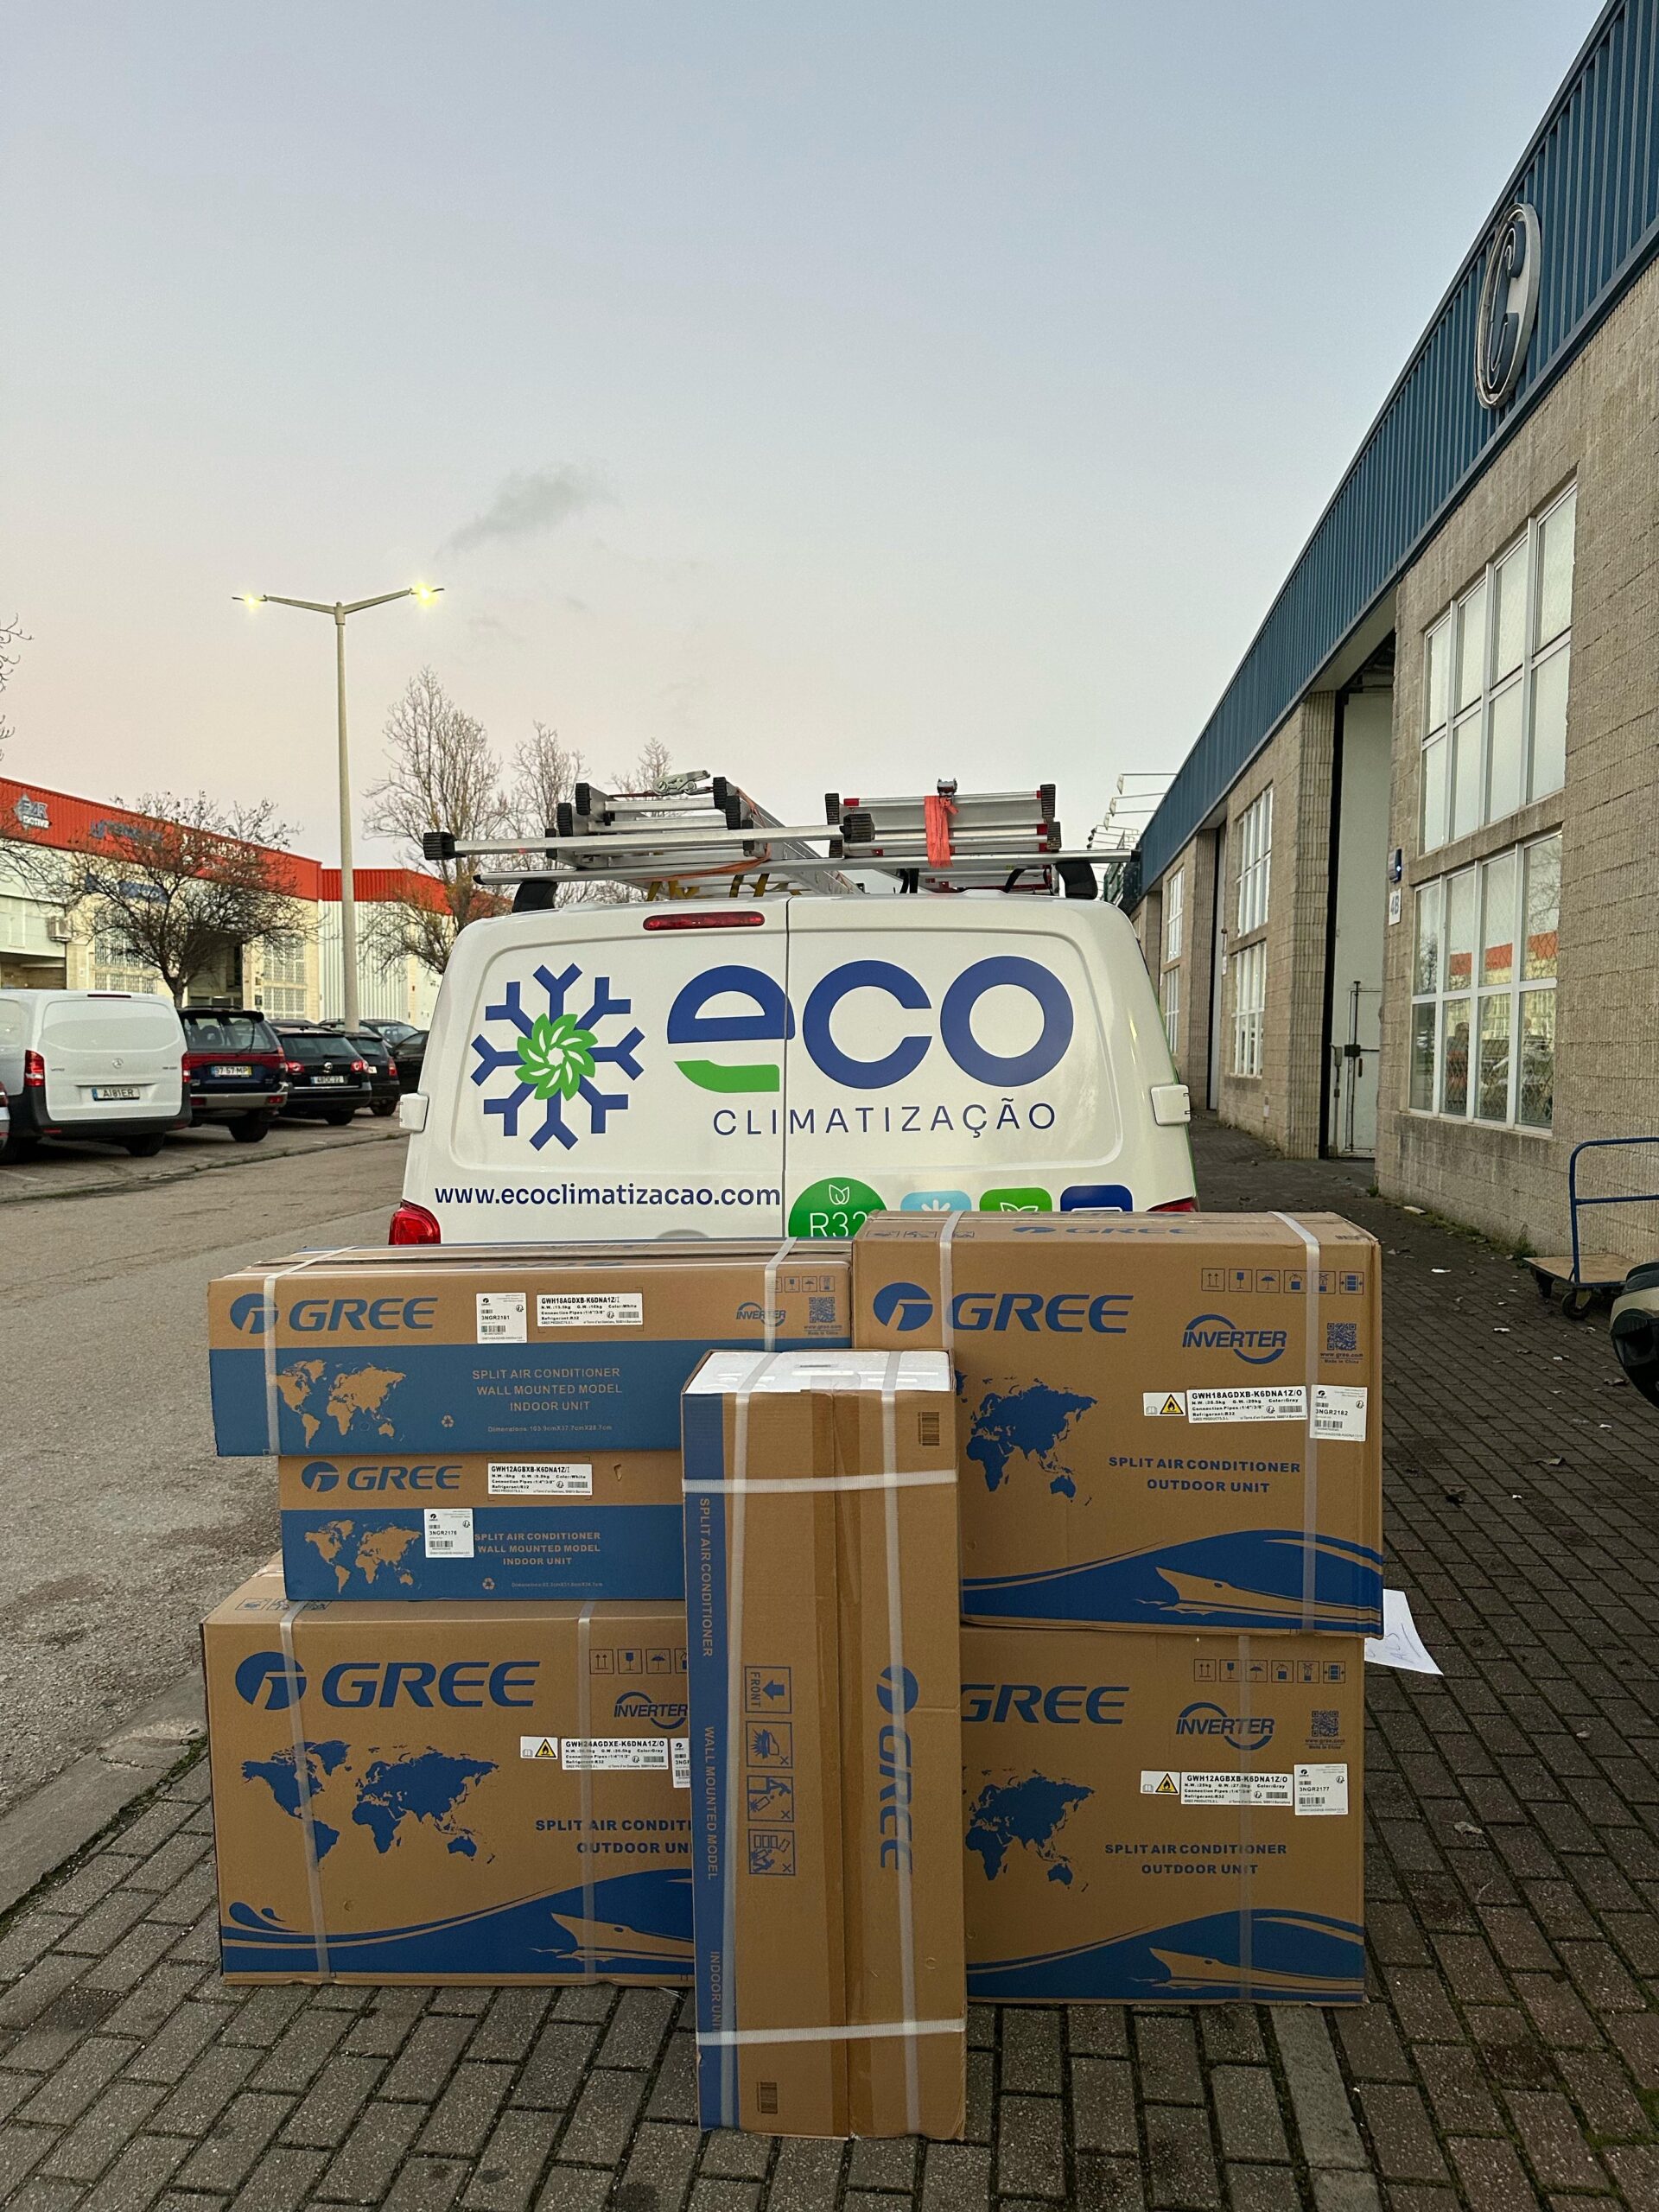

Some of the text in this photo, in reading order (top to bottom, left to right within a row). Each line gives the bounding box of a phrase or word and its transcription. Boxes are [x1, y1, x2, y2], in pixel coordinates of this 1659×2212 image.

[1389, 894, 1400, 916] 4B
[668, 956, 1074, 1093] eco
[713, 1097, 1056, 1138] CLIMATIZAÇÃO
[434, 1182, 779, 1205] www.ecoclimatizacao.com
[289, 1297, 438, 1332] GREE
[736, 1310, 786, 1319] INVERER
[946, 1293, 1134, 1334] GREE
[1182, 1330, 1287, 1348] INVERTER
[472, 1368, 620, 1380] SPLIT AIR CONDITIONER
[477, 1383, 623, 1395] WALL MOUNTED MODEL
[510, 1401, 590, 1411] INDOOR UNIT
[1109, 1457, 1300, 1472] SPLIT AIR CONDITIONER
[347, 1465, 462, 1491] GREE
[1147, 1478, 1270, 1493] OUTDOOR UNIT
[700, 1498, 713, 1657] SPLIT AIR CONDITIONER
[321, 1661, 541, 1707] GREE
[750, 1671, 761, 1708] FRONT
[613, 1704, 689, 1718] INVERTER
[961, 1684, 1130, 1725] GREE
[1176, 1718, 1275, 1735] INVERTER
[704, 1726, 718, 1880] WALL MOUNTED MODEL
[879, 1725, 913, 1875] GREE
[536, 1820, 582, 1831] SPLIT
[590, 1820, 617, 1831] AIR
[576, 1842, 660, 1853] OUTDOOR
[1105, 1845, 1287, 1854] SPLIT AIR CONDITIONER
[1141, 1864, 1259, 1874] OUTDOOR UNIT
[710, 1951, 721, 2002] INDOOR
